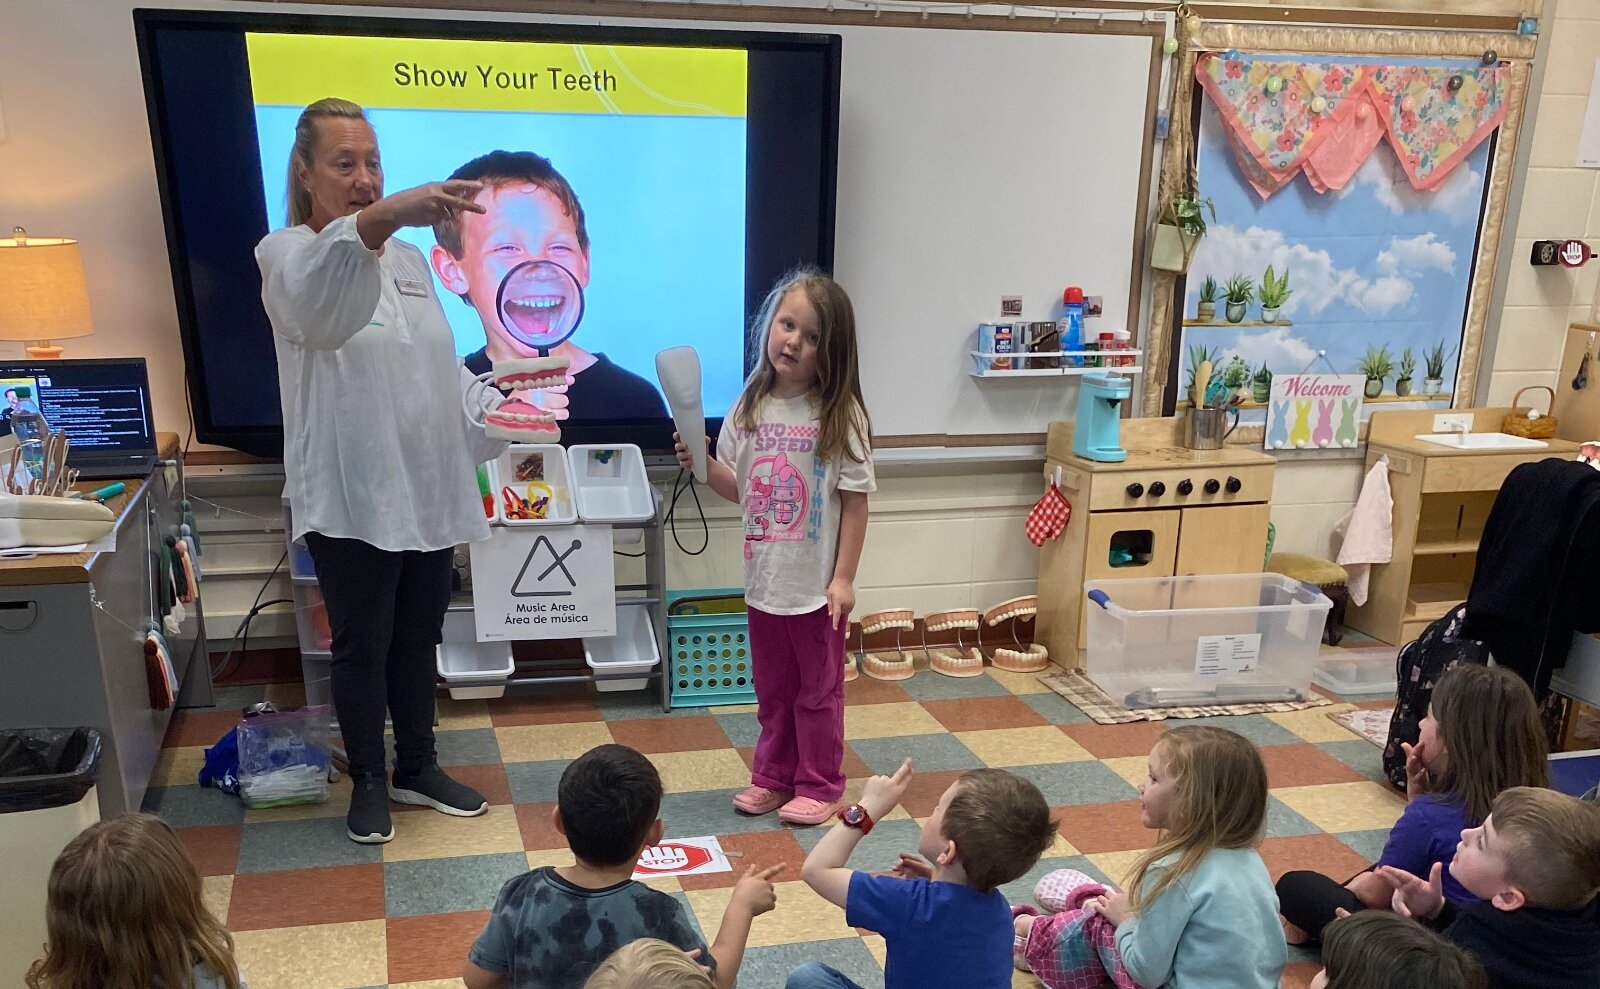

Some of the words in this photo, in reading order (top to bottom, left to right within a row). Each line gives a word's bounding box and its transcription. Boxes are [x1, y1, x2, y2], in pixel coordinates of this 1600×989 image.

[394, 62, 468, 88] Show
[476, 65, 539, 90] Your
[547, 67, 617, 92] Teeth
[1282, 376, 1352, 397] Welcome
[754, 437, 813, 453] SPEED
[516, 602, 547, 613] Music
[550, 602, 576, 611] Area
[504, 612, 530, 625] Área
[533, 614, 548, 624] de
[551, 612, 589, 624] música
[643, 857, 685, 866] STOP
